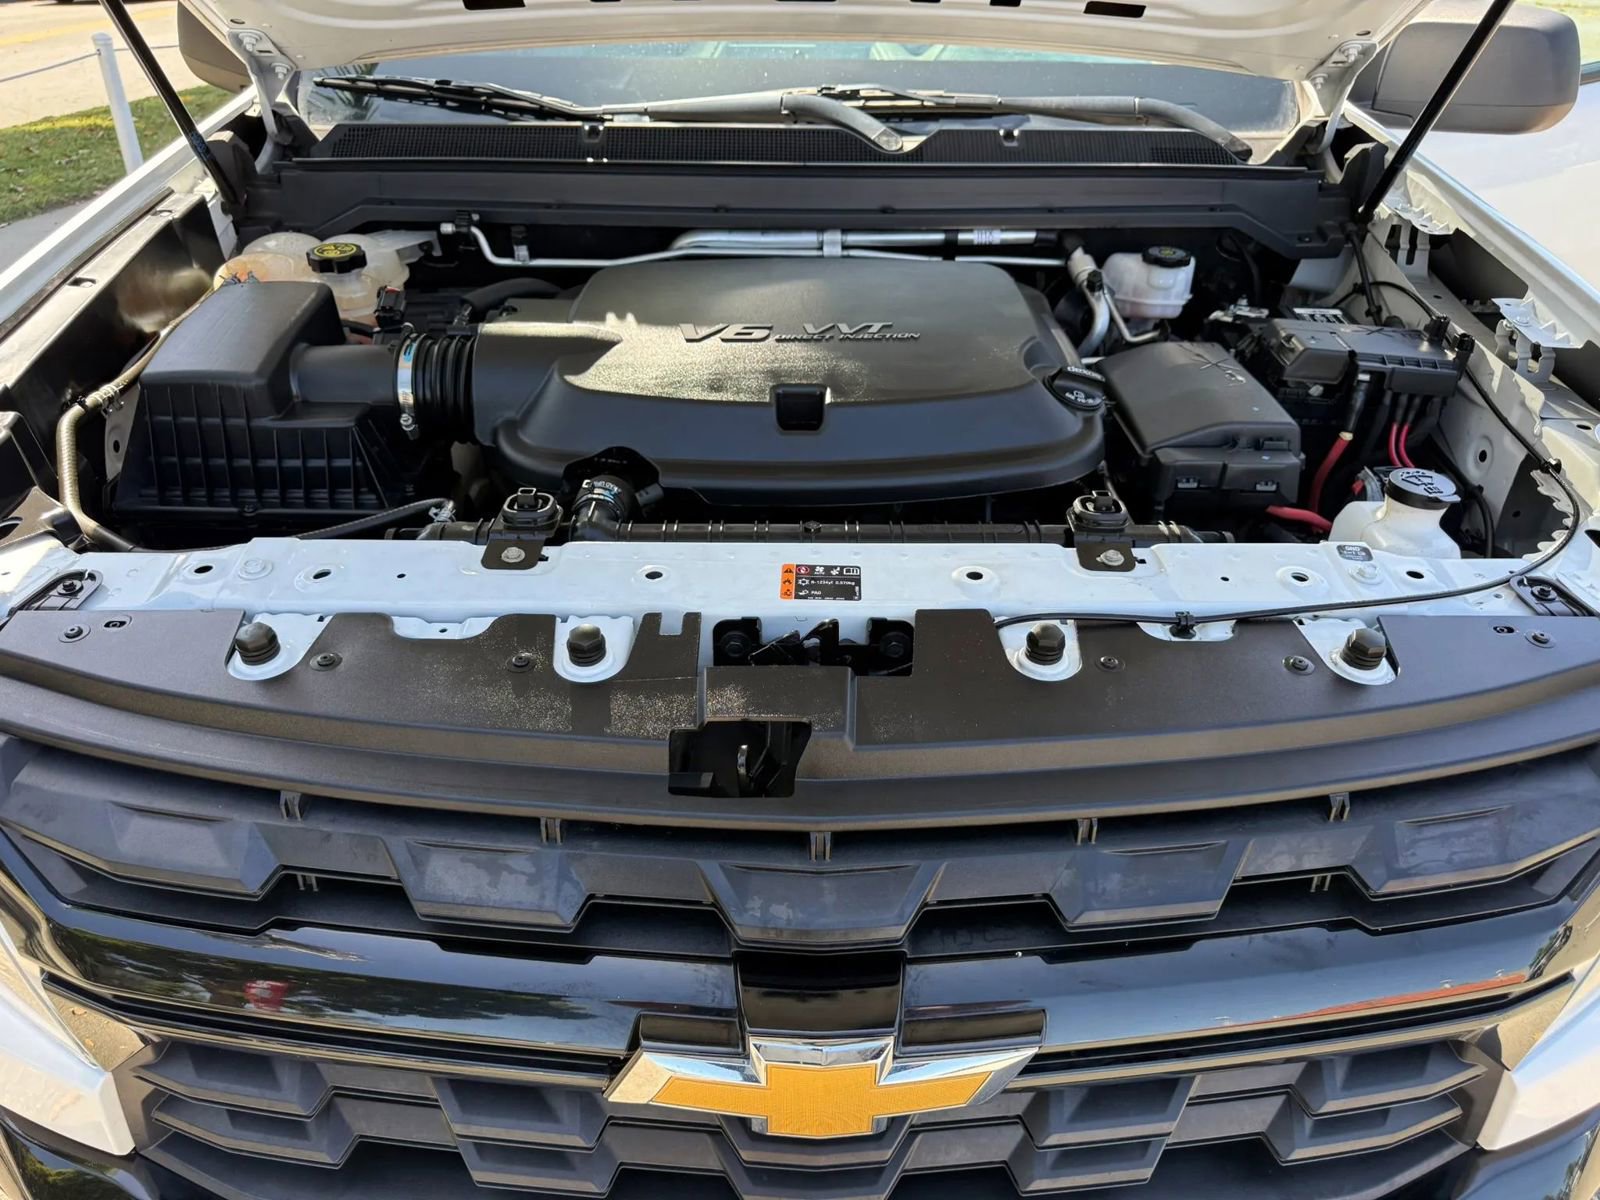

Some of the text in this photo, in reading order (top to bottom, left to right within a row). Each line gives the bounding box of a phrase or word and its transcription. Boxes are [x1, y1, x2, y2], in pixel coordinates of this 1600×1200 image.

[679, 323, 773, 343] V6
[802, 321, 894, 335] VVT
[774, 331, 921, 342] DIRECT INJECTION
